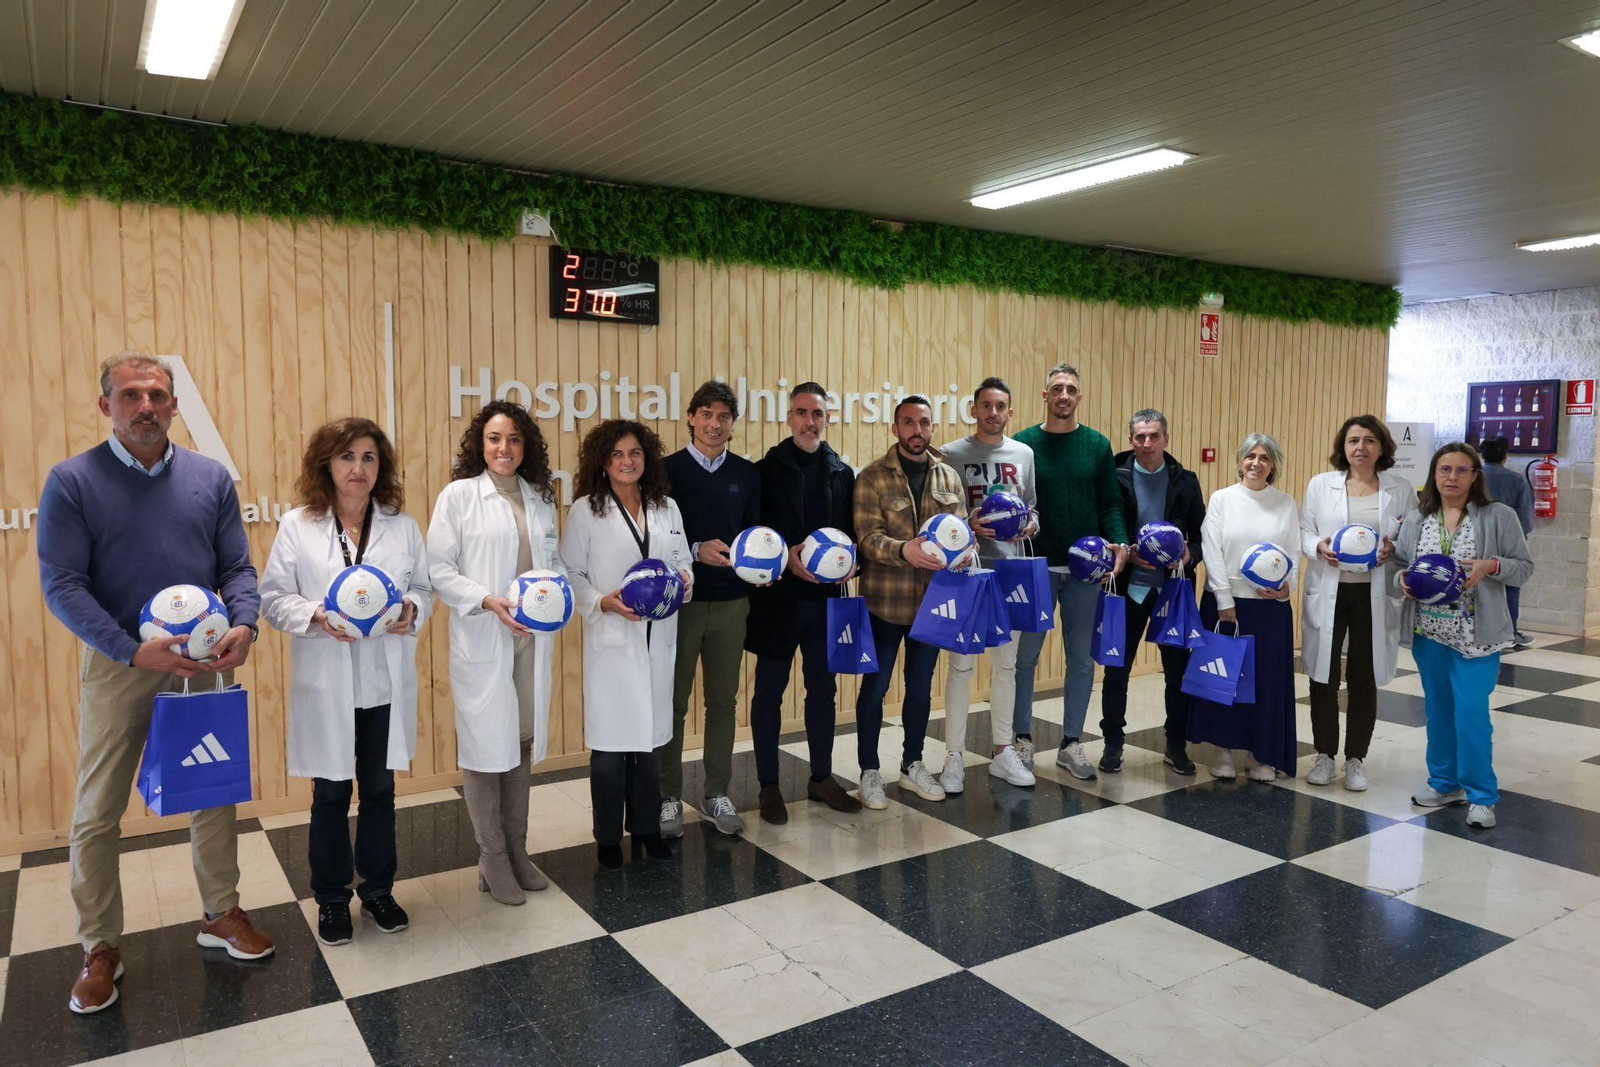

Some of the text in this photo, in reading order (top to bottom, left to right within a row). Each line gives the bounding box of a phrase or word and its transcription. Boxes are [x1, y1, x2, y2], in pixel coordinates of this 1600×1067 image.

[563, 254, 580, 279] 2
[635, 299, 650, 309] HR
[450, 366, 681, 431] Hospital
[715, 375, 978, 424] Uniersitrio
